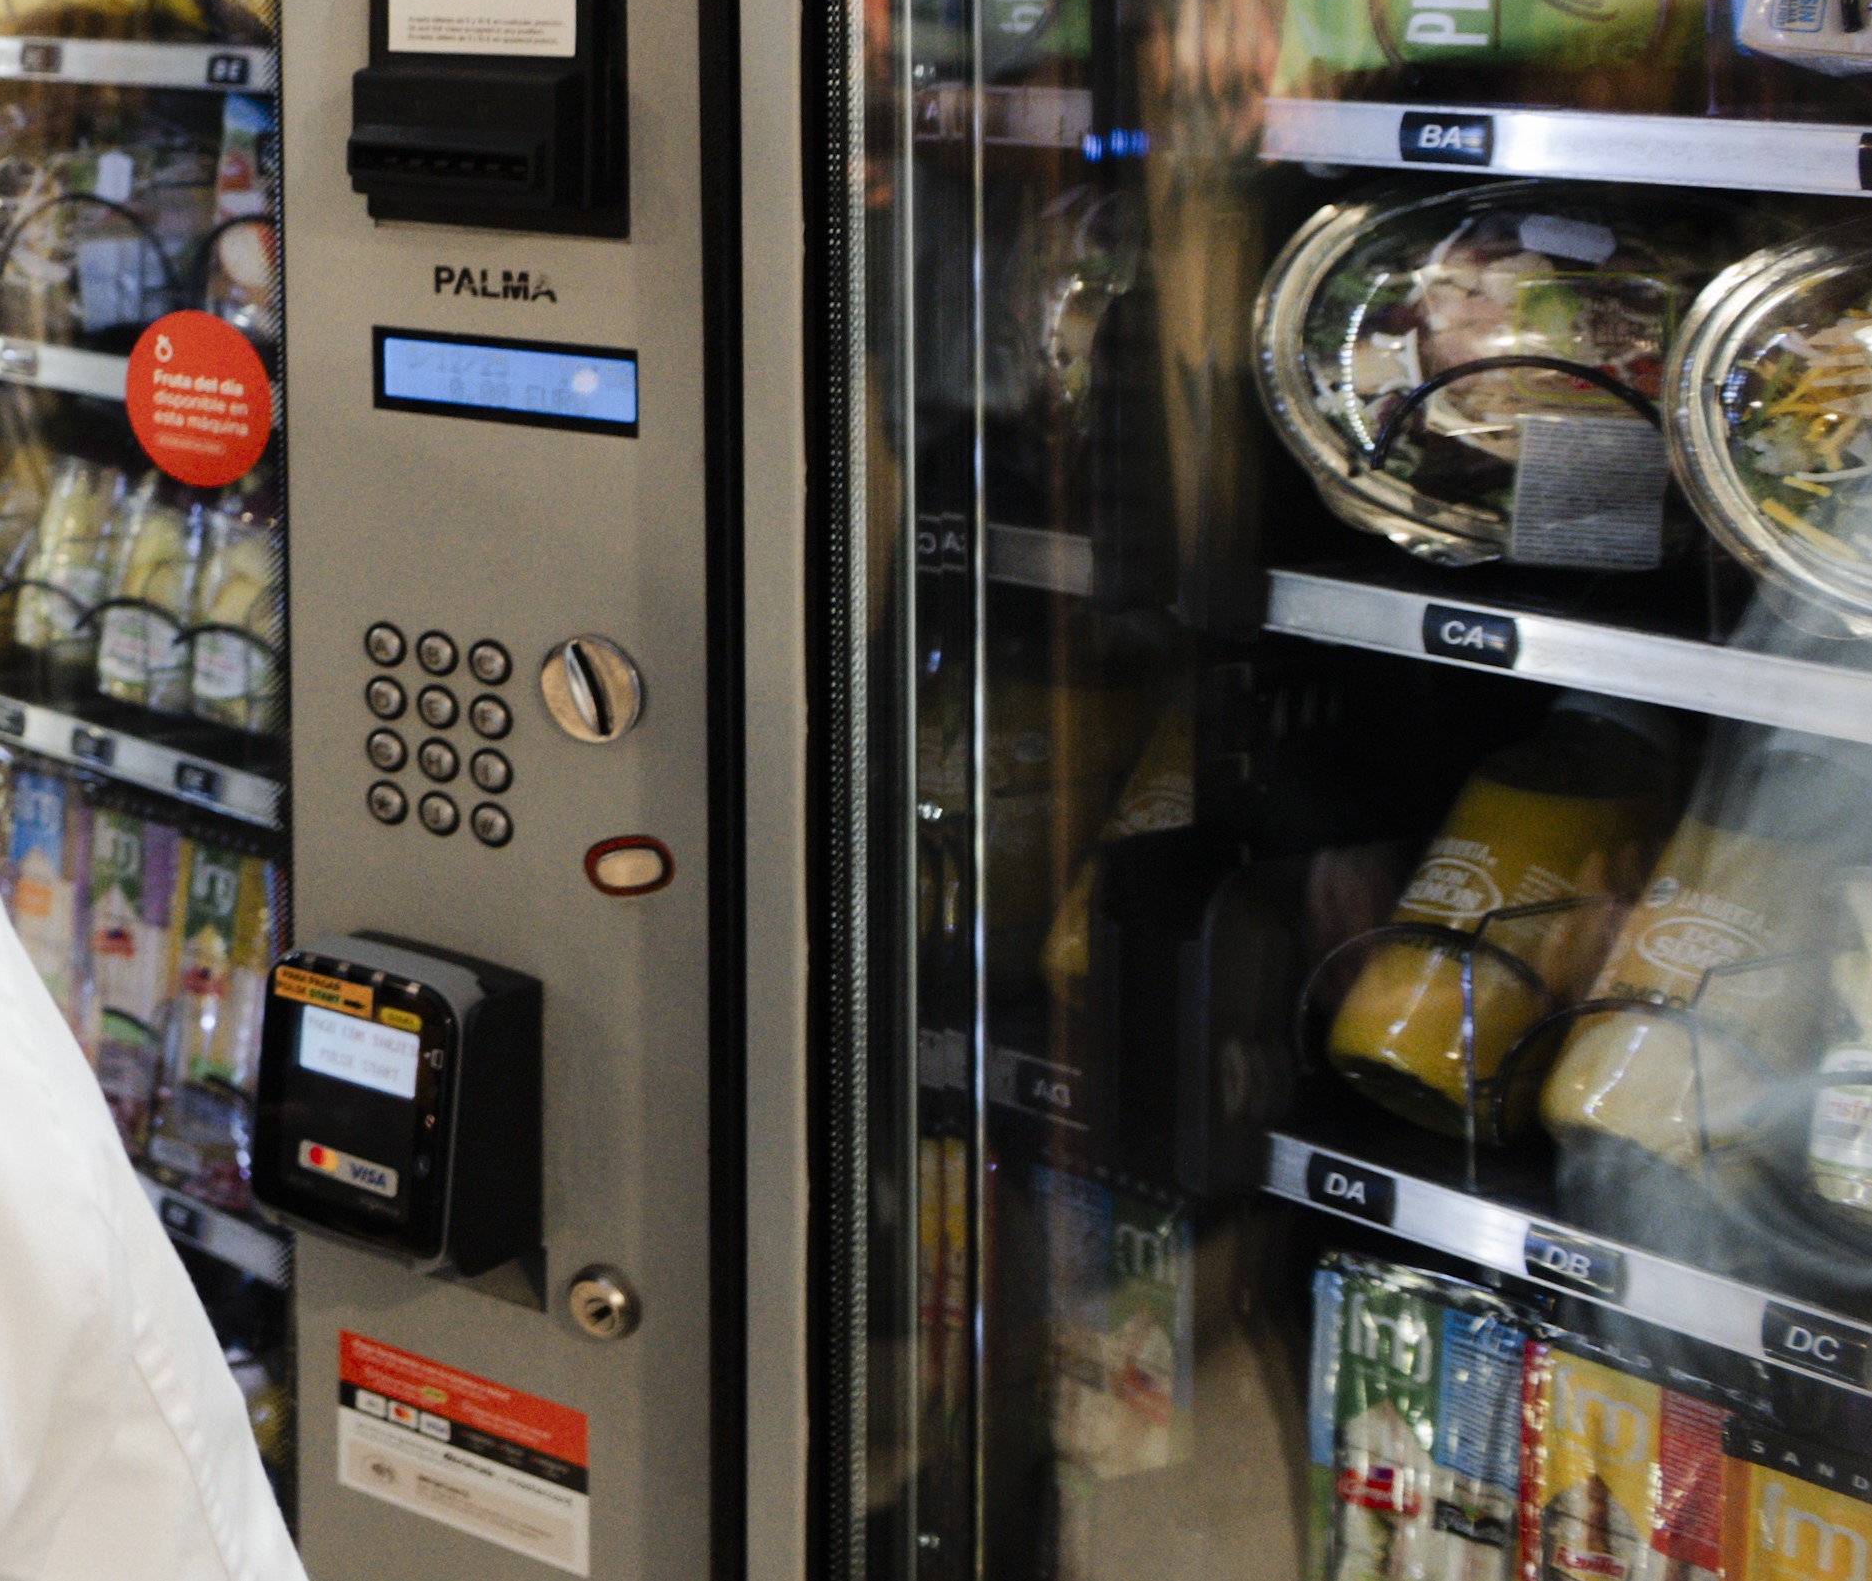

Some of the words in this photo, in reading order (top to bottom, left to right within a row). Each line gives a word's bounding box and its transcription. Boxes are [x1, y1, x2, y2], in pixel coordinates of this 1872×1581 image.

[1418, 124, 1463, 150] BA
[434, 265, 557, 303] PALMA
[153, 369, 191, 390] Fruta
[194, 374, 218, 394] del
[220, 377, 244, 397] día
[153, 390, 227, 414] disponible
[229, 402, 249, 417] en
[153, 411, 185, 428] esta
[187, 415, 249, 437] máquina
[1440, 620, 1485, 651] CA
[350, 1162, 387, 1189] VISA
[1324, 1171, 1367, 1207] DA
[1542, 1245, 1593, 1280] DB
[1784, 1325, 1840, 1363] DC
